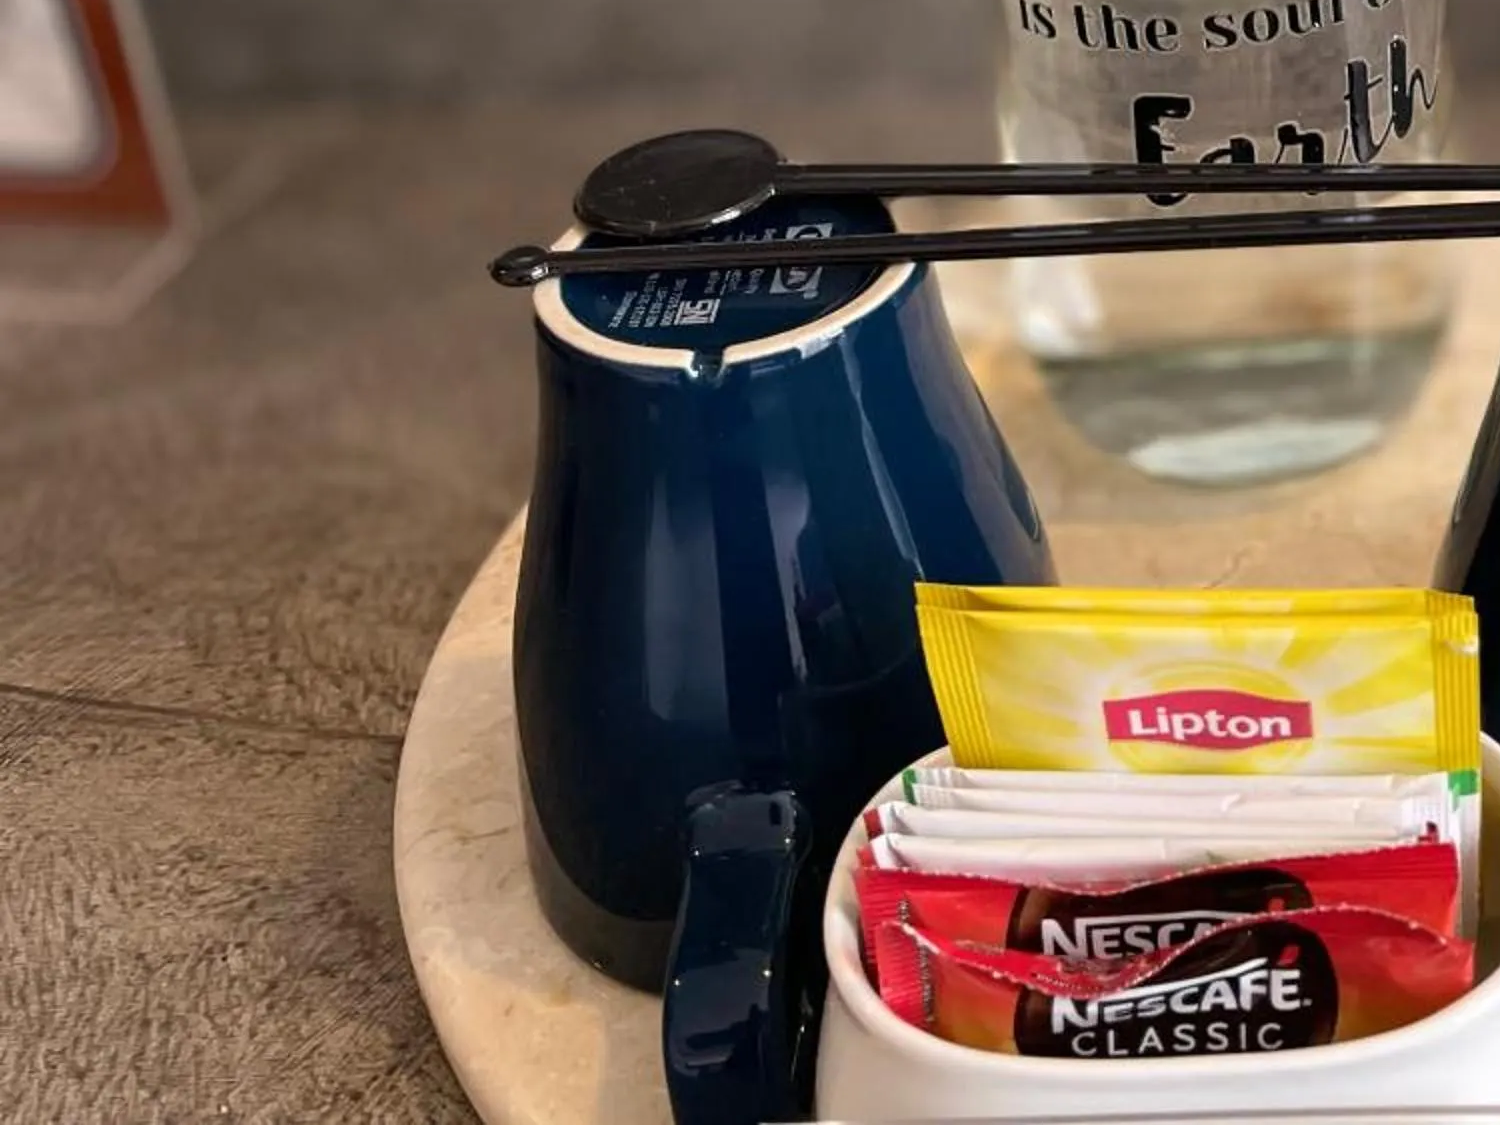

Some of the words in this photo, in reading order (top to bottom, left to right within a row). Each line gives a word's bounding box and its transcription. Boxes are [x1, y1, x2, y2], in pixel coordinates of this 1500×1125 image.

[1073, 4, 1178, 51] the
[1128, 706, 1292, 740] Lipton
[1071, 1022, 1283, 1056] CLASSIC
